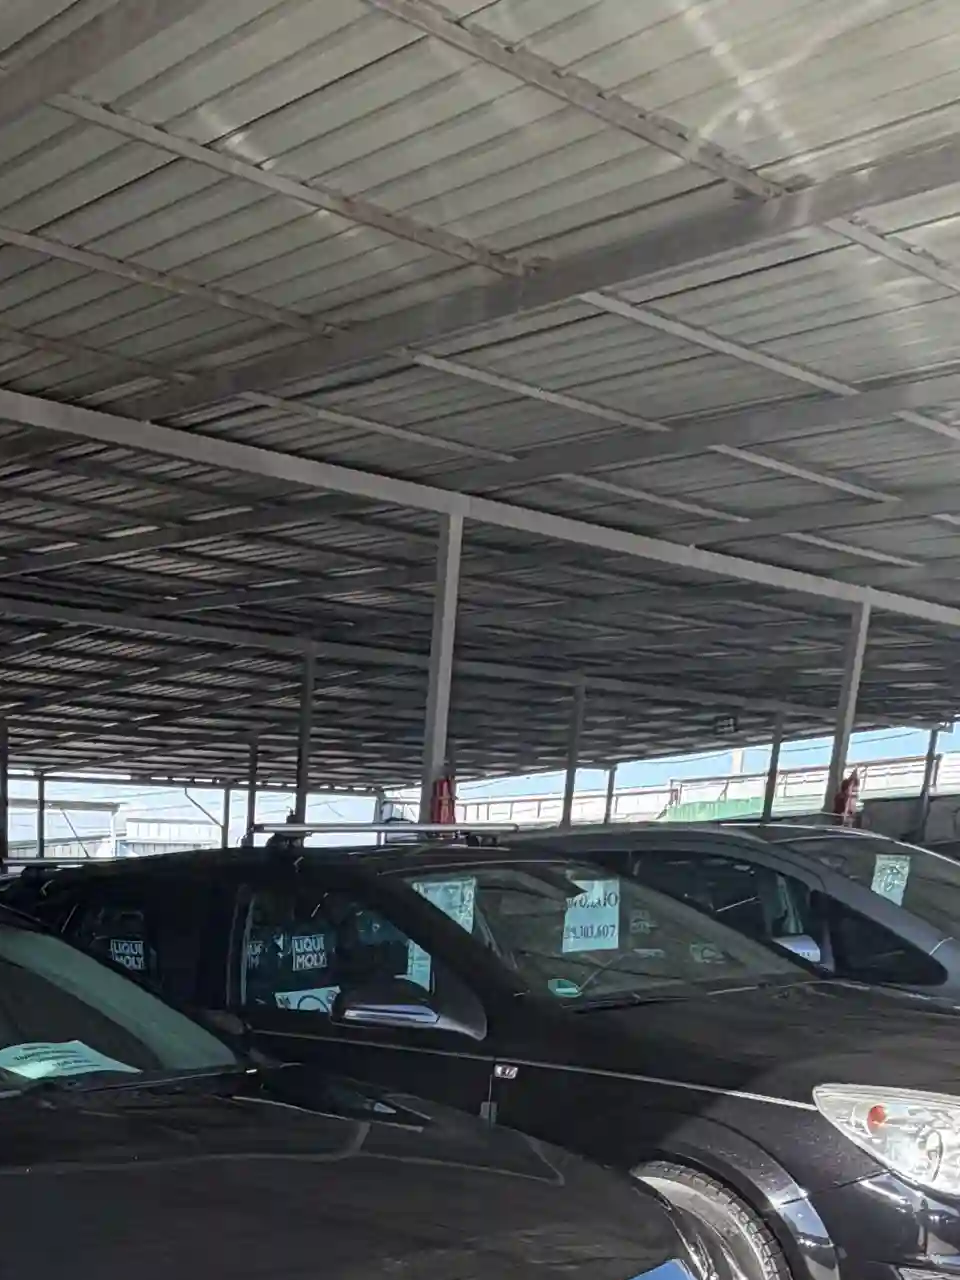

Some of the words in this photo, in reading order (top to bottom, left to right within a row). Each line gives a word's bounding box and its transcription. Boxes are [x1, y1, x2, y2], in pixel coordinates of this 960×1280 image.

[113, 941, 142, 954] LIQUI
[295, 937, 325, 953] LIQUI
[296, 953, 327, 969] MOLY
